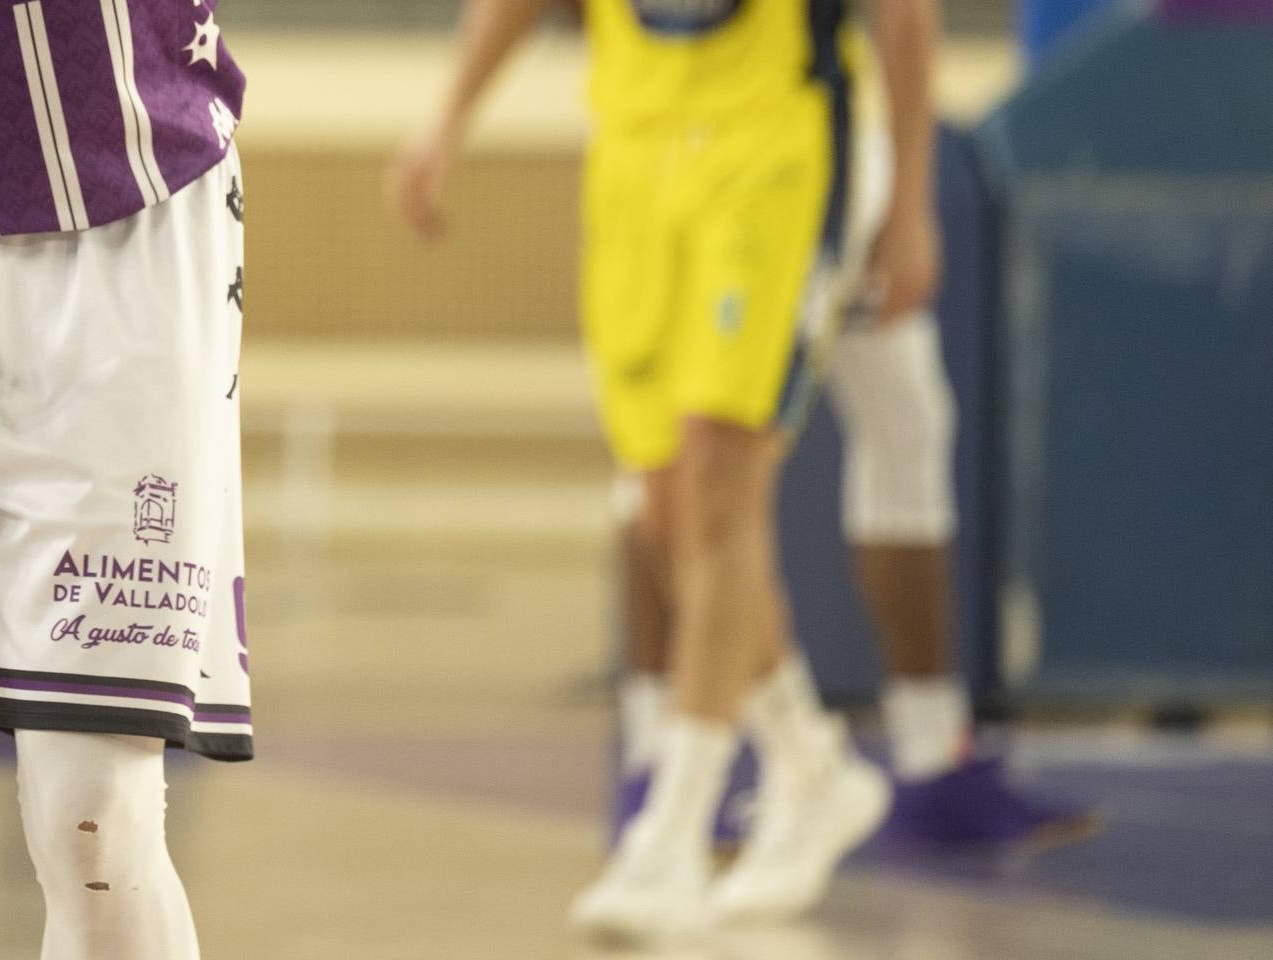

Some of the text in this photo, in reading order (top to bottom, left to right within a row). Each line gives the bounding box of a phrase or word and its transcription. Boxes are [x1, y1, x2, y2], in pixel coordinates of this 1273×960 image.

[53, 584, 82, 603] DE
[50, 614, 87, 642] A
[80, 622, 155, 650] gusto
[152, 625, 181, 648] de
